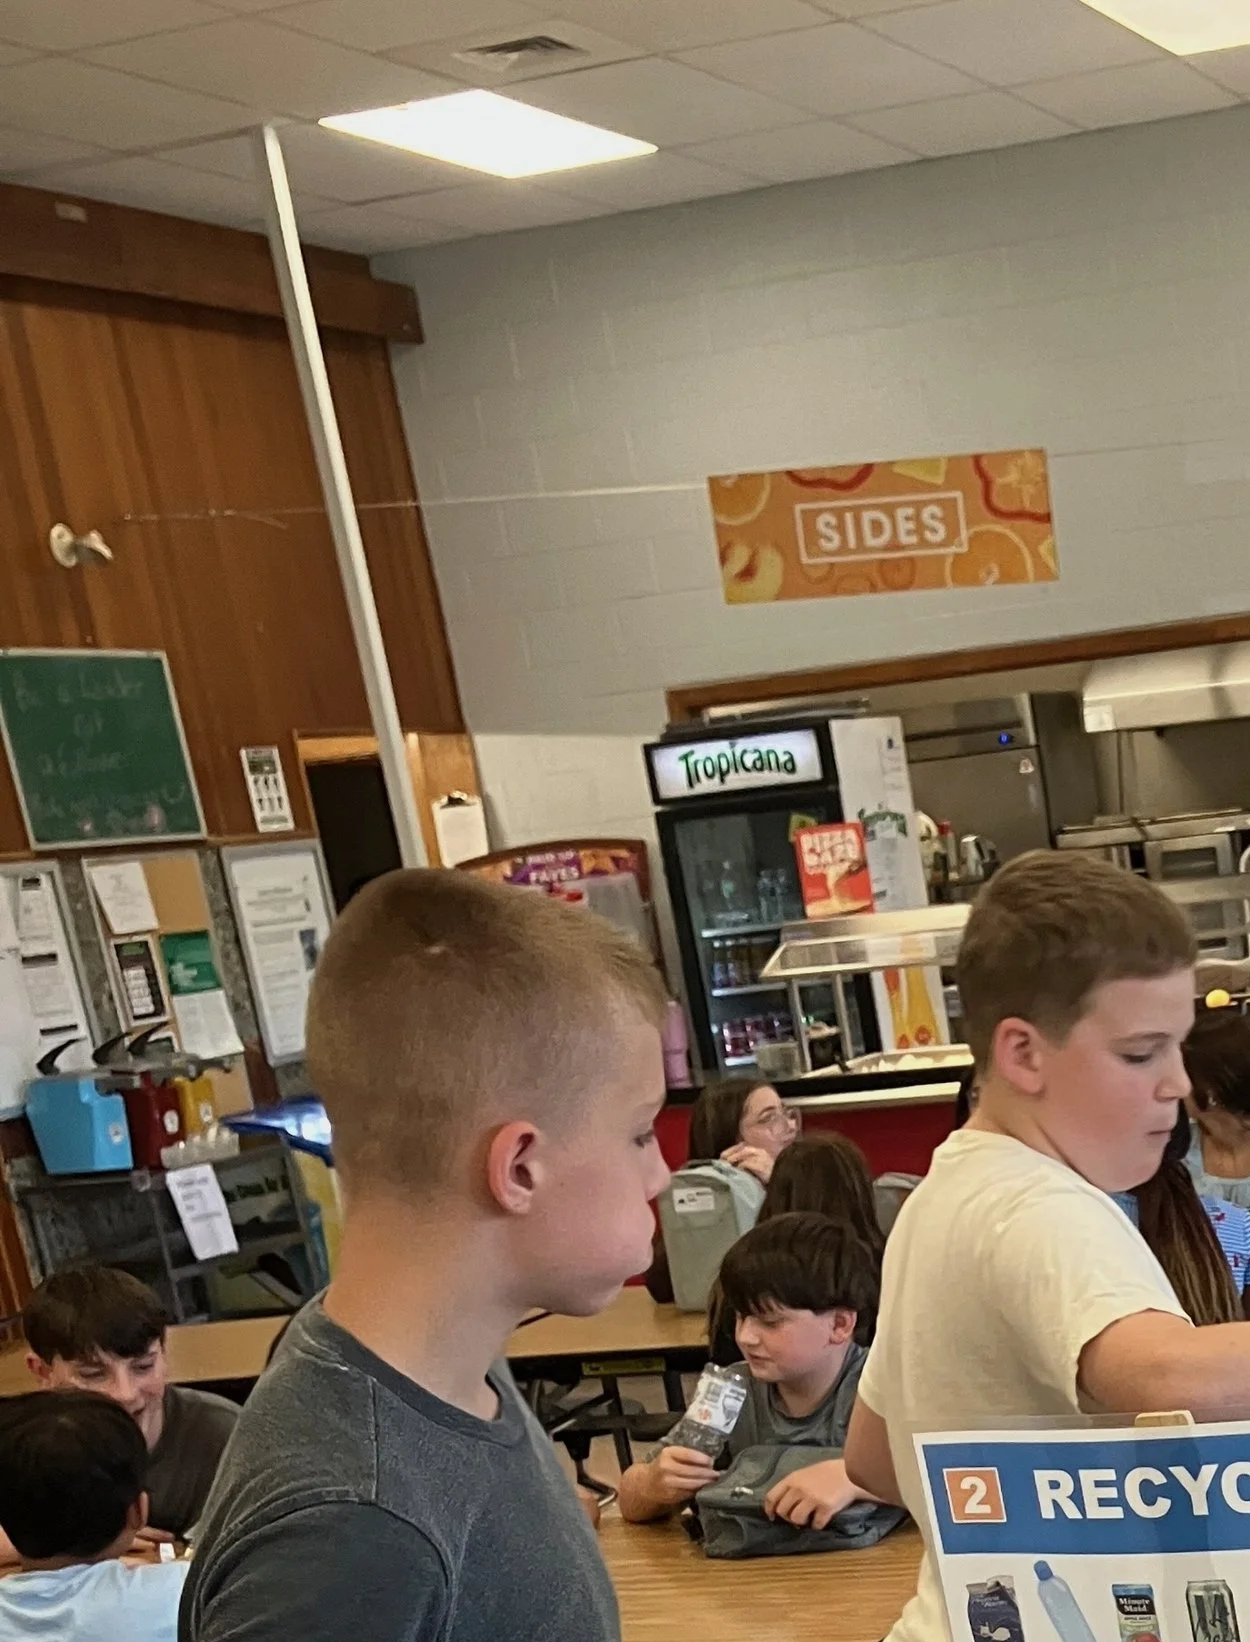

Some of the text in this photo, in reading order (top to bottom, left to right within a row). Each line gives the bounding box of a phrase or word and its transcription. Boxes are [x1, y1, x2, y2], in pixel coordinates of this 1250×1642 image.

[815, 503, 948, 552] SIDES
[678, 741, 797, 789] Tropicana
[962, 1475, 993, 1514] 2
